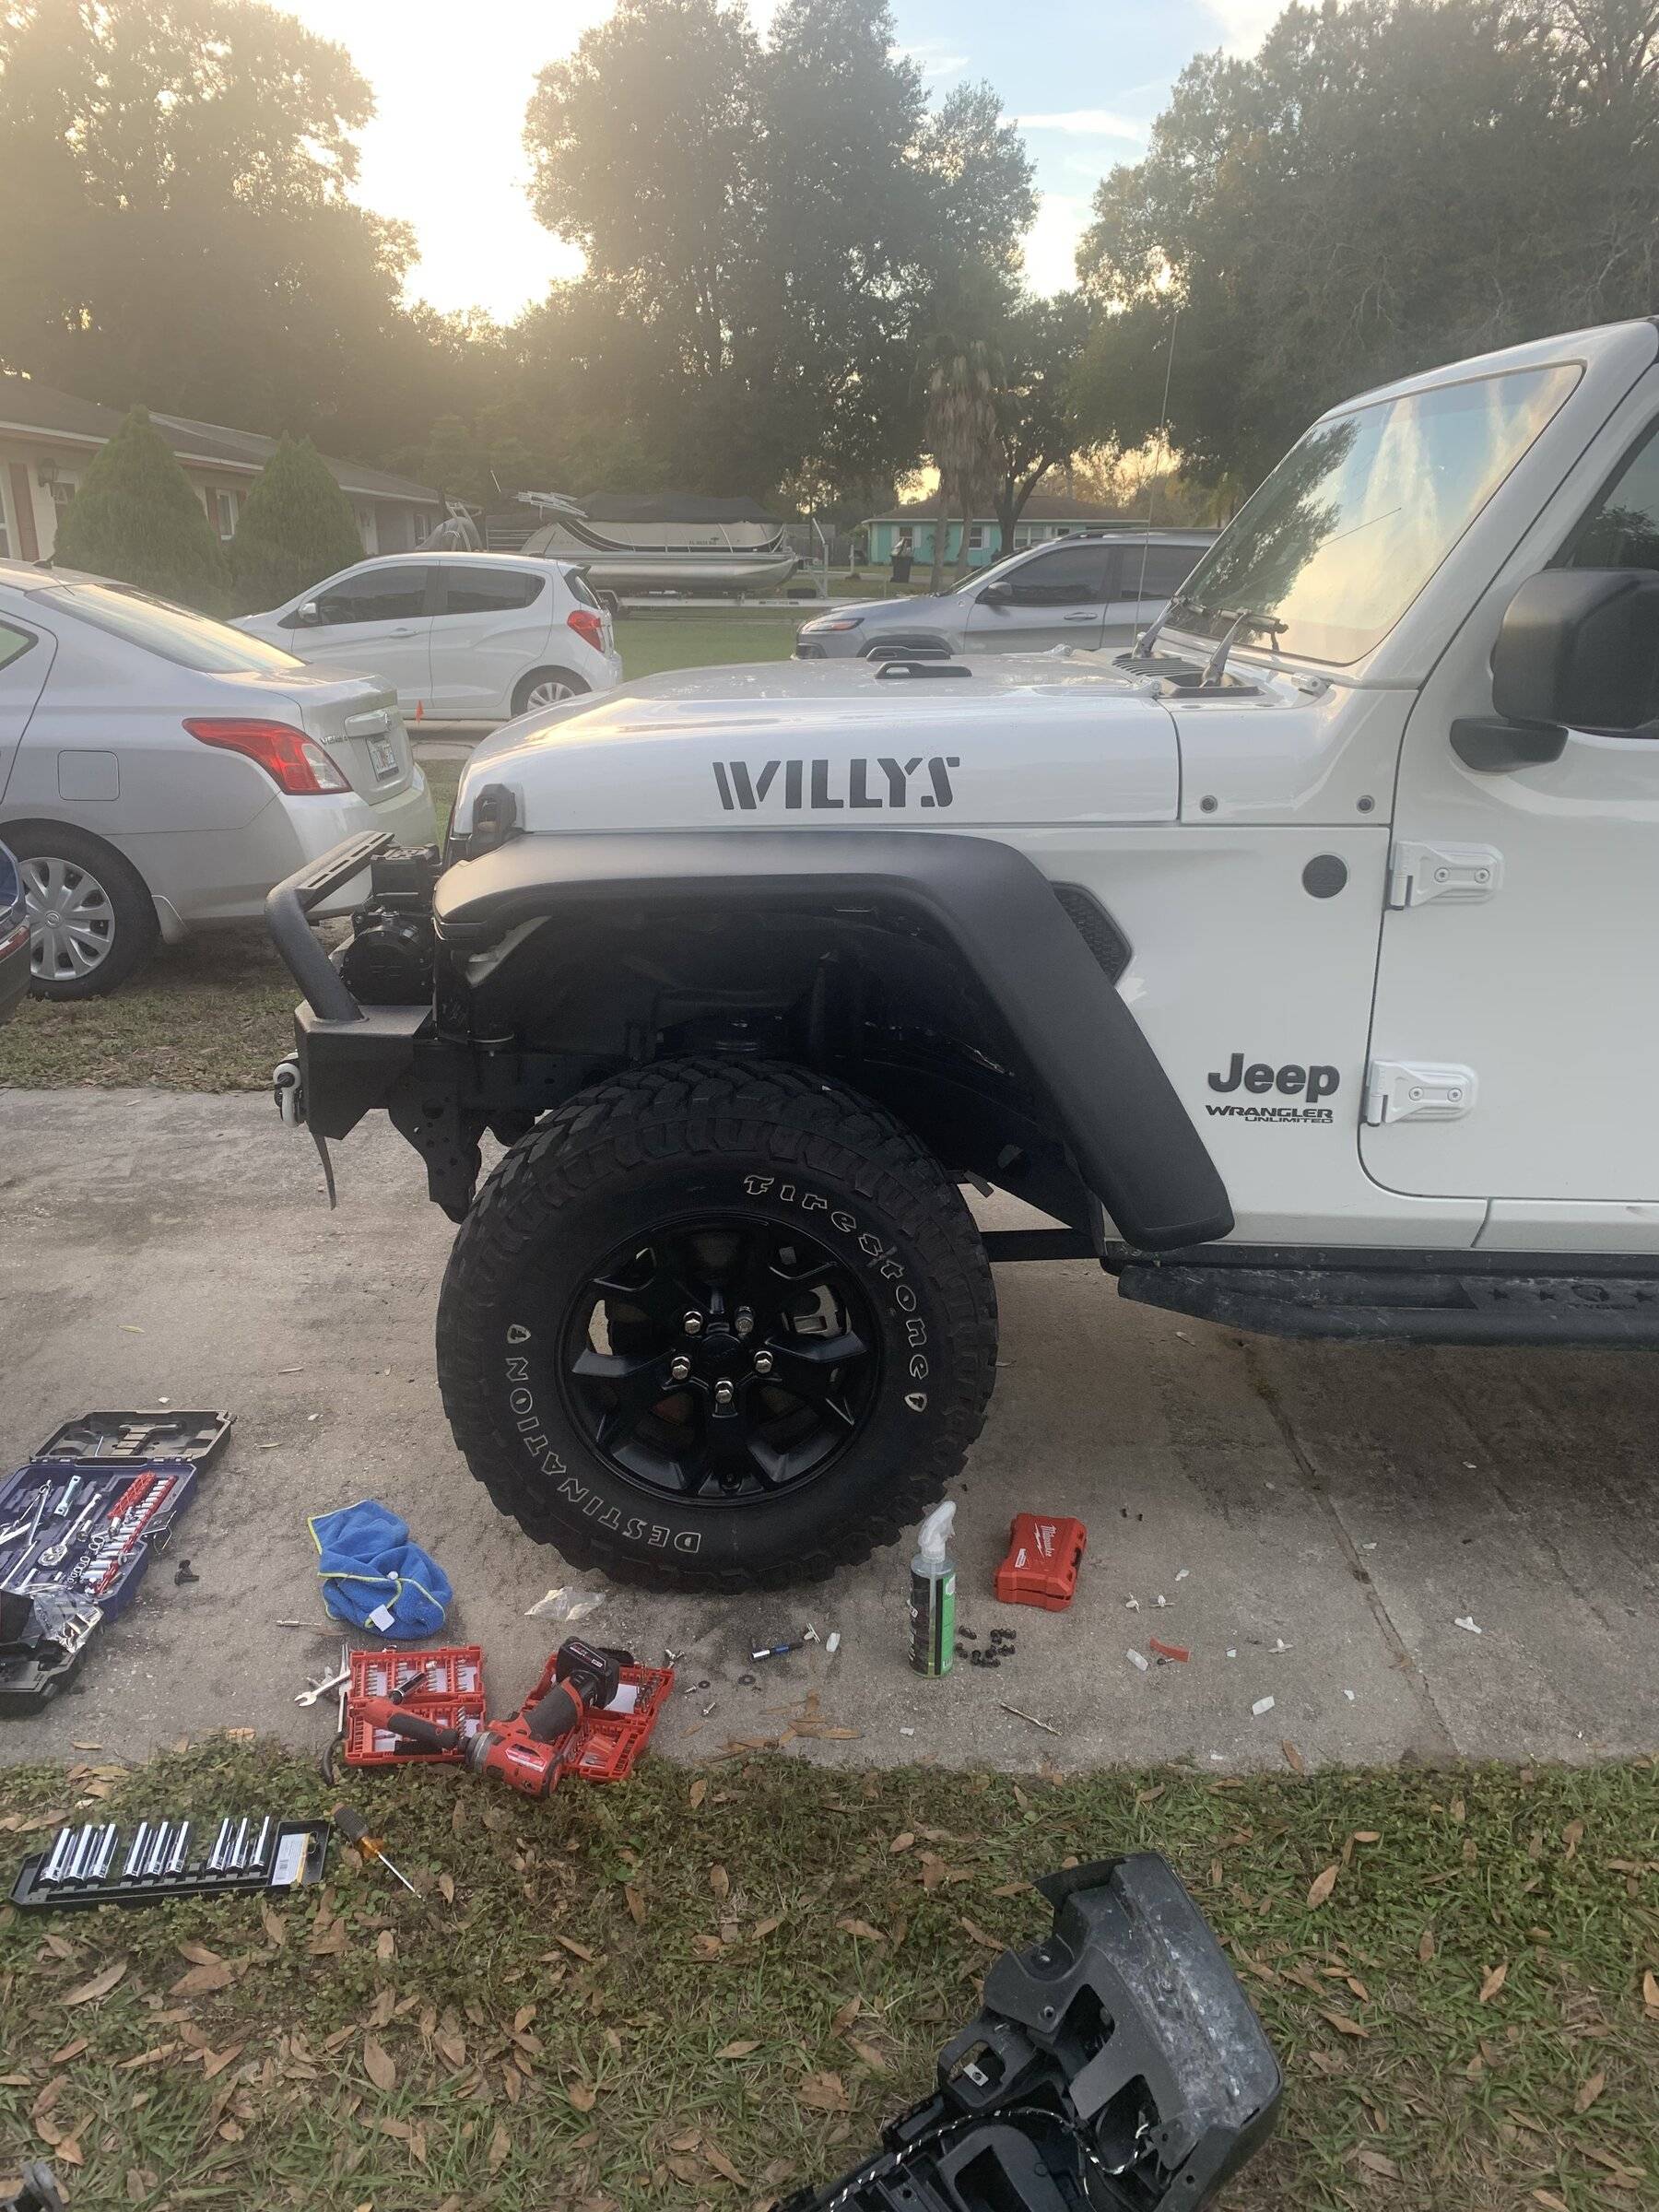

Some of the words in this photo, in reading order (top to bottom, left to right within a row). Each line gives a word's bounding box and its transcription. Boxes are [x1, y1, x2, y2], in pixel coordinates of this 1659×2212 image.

[712, 757, 959, 809] WILLYS
[1207, 1053, 1340, 1102] Jeep
[1206, 1105, 1333, 1118] WRANGLER
[744, 1175, 928, 1380] Firestone
[505, 1357, 701, 1553] DESTINATION
